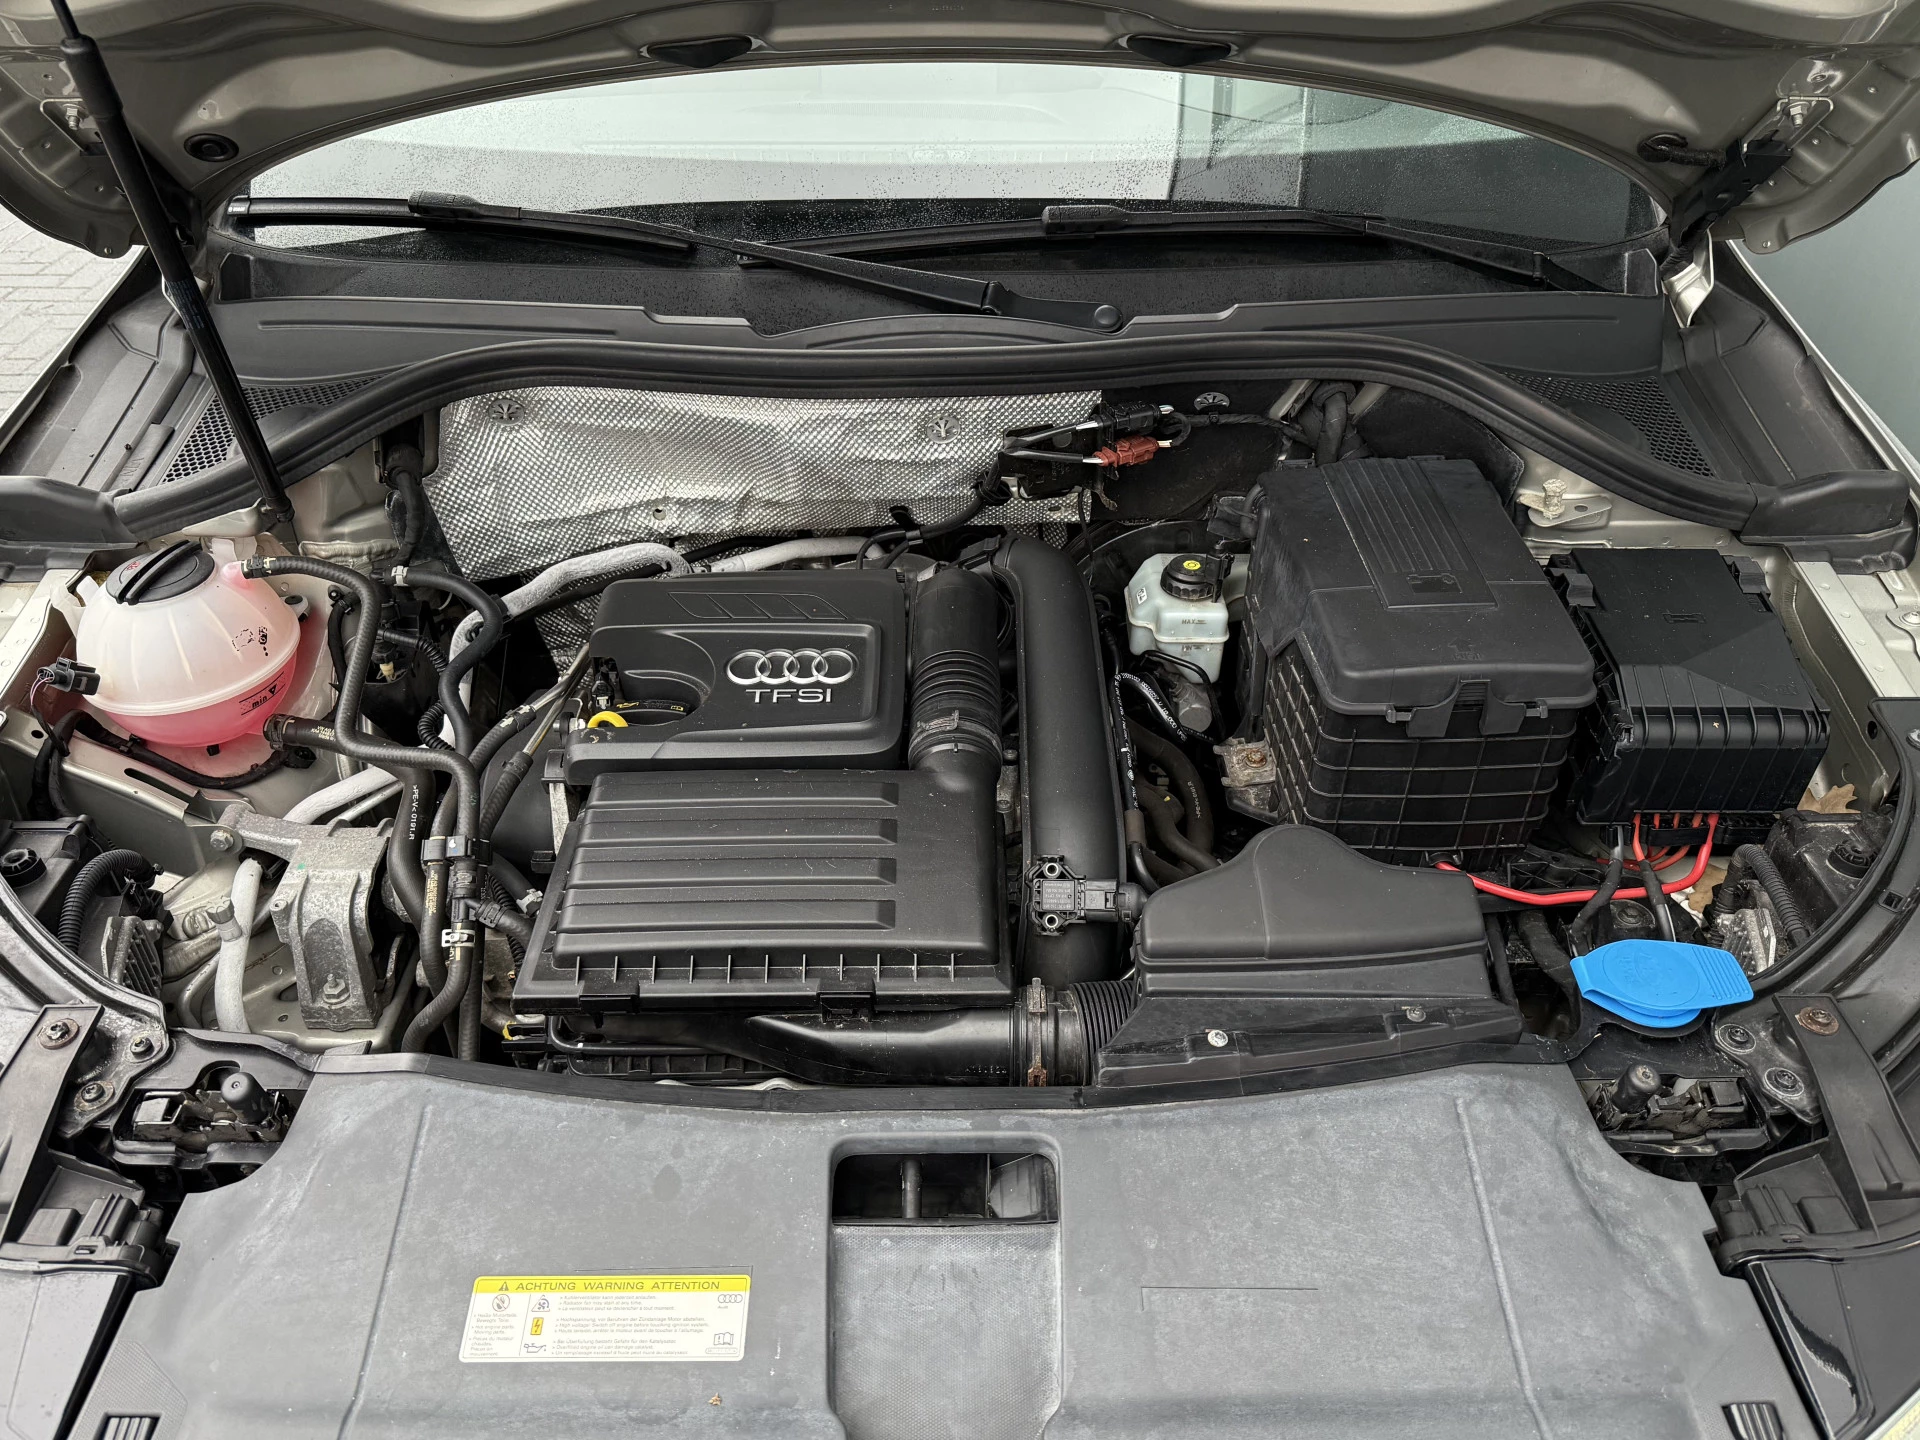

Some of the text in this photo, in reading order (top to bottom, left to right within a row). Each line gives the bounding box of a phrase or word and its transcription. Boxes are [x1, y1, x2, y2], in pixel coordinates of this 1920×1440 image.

[251, 695, 268, 709] min
[745, 688, 833, 705] TFSI
[515, 1281, 721, 1291] ACHTUNG WARNING ATTENTION
